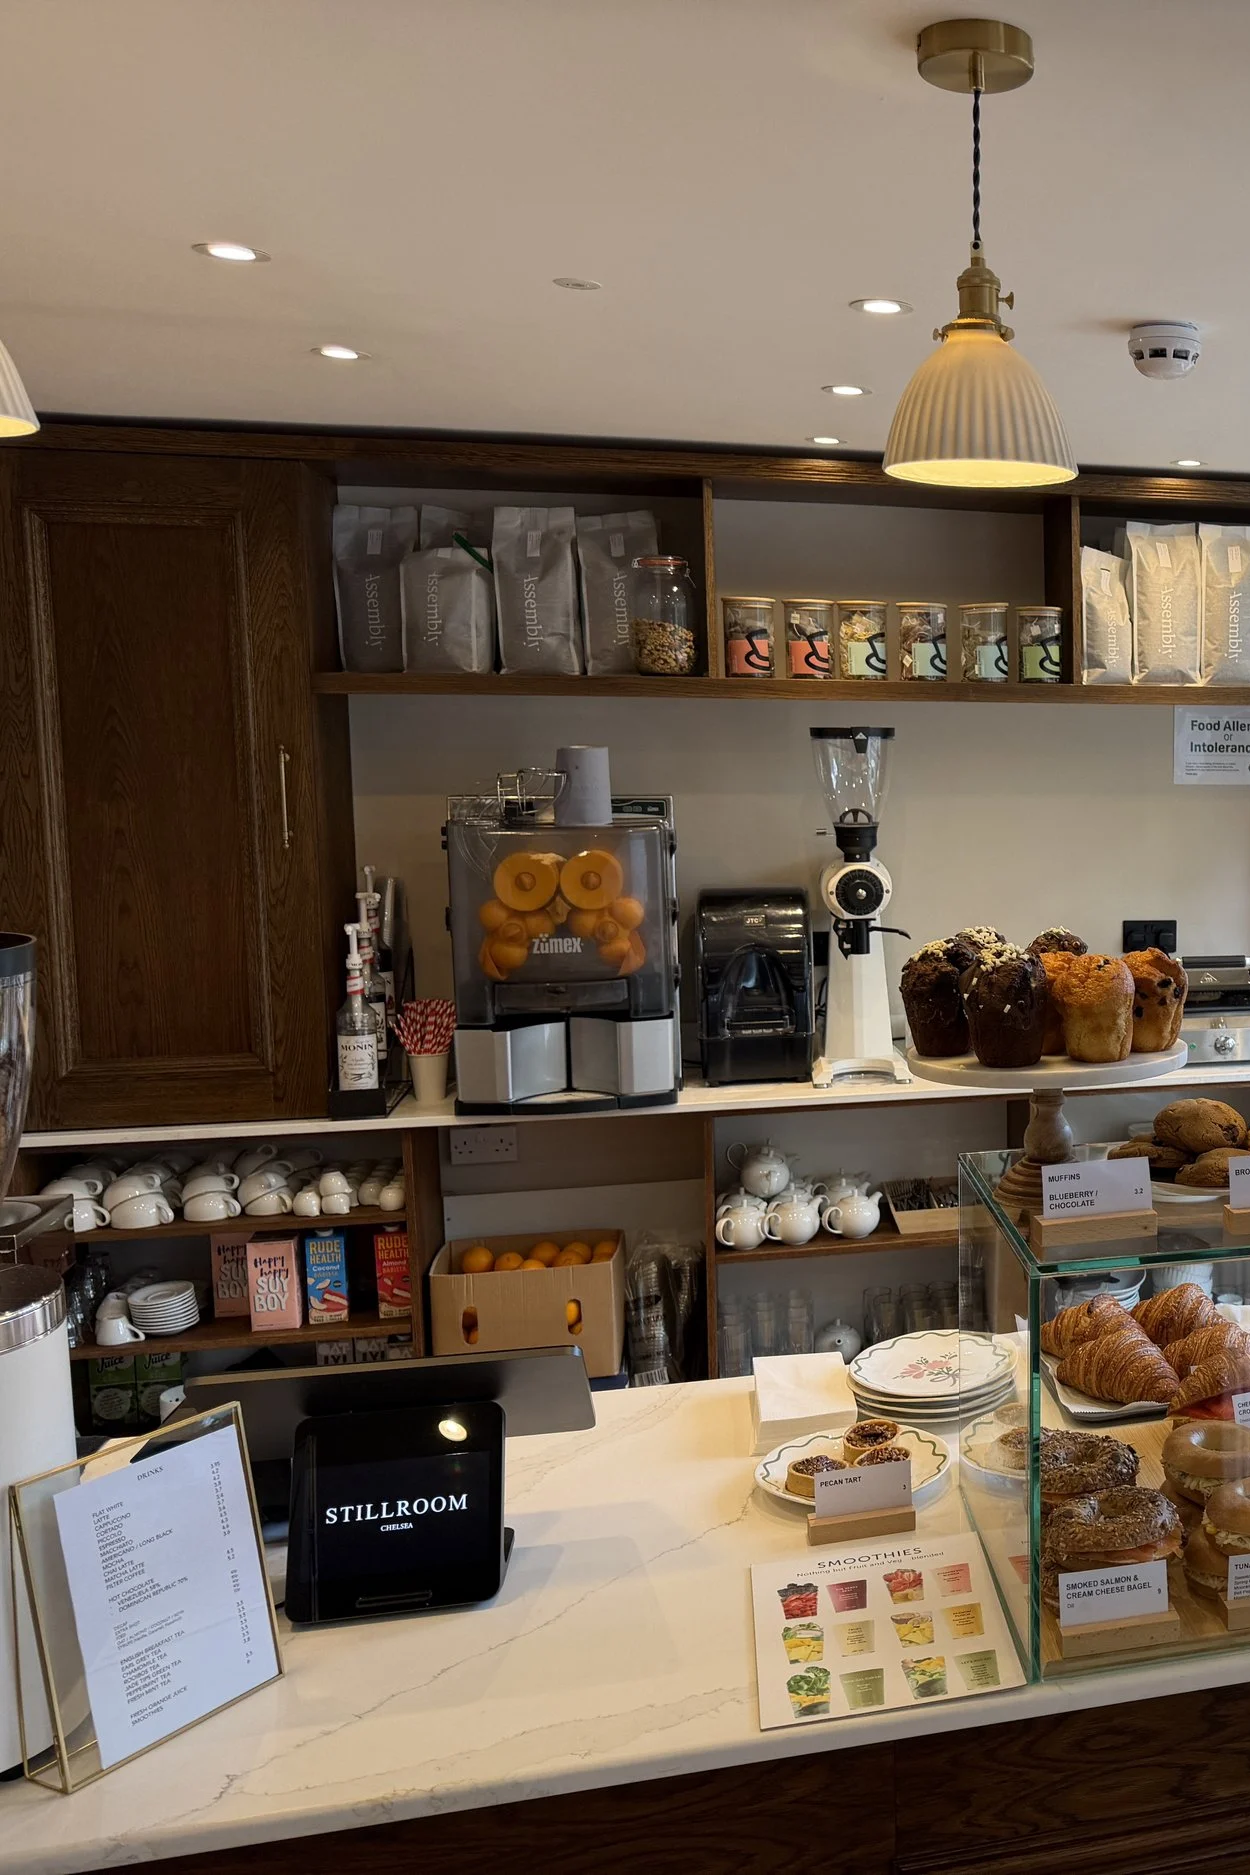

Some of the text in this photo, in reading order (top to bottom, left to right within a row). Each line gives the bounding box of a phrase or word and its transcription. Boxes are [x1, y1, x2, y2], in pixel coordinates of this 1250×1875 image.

[365, 573, 385, 649] Assembly
[524, 575, 543, 651] Assembly
[1158, 586, 1176, 659] Assembly
[1224, 591, 1243, 663] Assembly
[1190, 720, 1220, 731] Food
[532, 933, 582, 954] zümex
[340, 1044, 374, 1052] MONIN
[1048, 1173, 1080, 1182] MUFFINS
[1049, 1191, 1094, 1201] BLUEBERRY
[1049, 1200, 1095, 1210] CHOCOLATE
[310, 1240, 340, 1254] RUDE
[378, 1236, 408, 1249] RUDE
[254, 1256, 285, 1269] Happy
[309, 1253, 342, 1264] HEALTH
[260, 1268, 289, 1279] happy
[254, 1293, 289, 1313] BOY
[820, 1479, 843, 1487] PECAN
[92, 1501, 123, 1519] FLAT WHITE
[324, 1494, 468, 1524] STILLROOM
[93, 1514, 110, 1525] LATTE
[94, 1512, 131, 1531] CAPPUCCINO
[96, 1522, 123, 1538] CORTADO
[380, 1522, 414, 1532] CHELSEA
[97, 1530, 122, 1545] PICCOLO
[99, 1535, 126, 1551] ESPRESSO
[102, 1558, 124, 1571] MOCHA
[796, 1569, 831, 1578] Nothing
[911, 1551, 945, 1561] blended
[817, 1547, 922, 1569] SMOOTHIES
[103, 1560, 134, 1577] CHAI LATTE
[104, 1561, 145, 1584] MATCHA LATTE
[124, 1568, 145, 1582] COFFEE
[121, 1578, 155, 1598] CHOCOLATE
[1066, 1580, 1098, 1590] SMOKED
[1100, 1576, 1131, 1586] SALMON
[1066, 1582, 1152, 1600] CREAM CHEESE BAGEL
[174, 1630, 185, 1639] TEA
[151, 1648, 162, 1658] TEA
[157, 1652, 168, 1661] TEA
[149, 1664, 160, 1672] TEA
